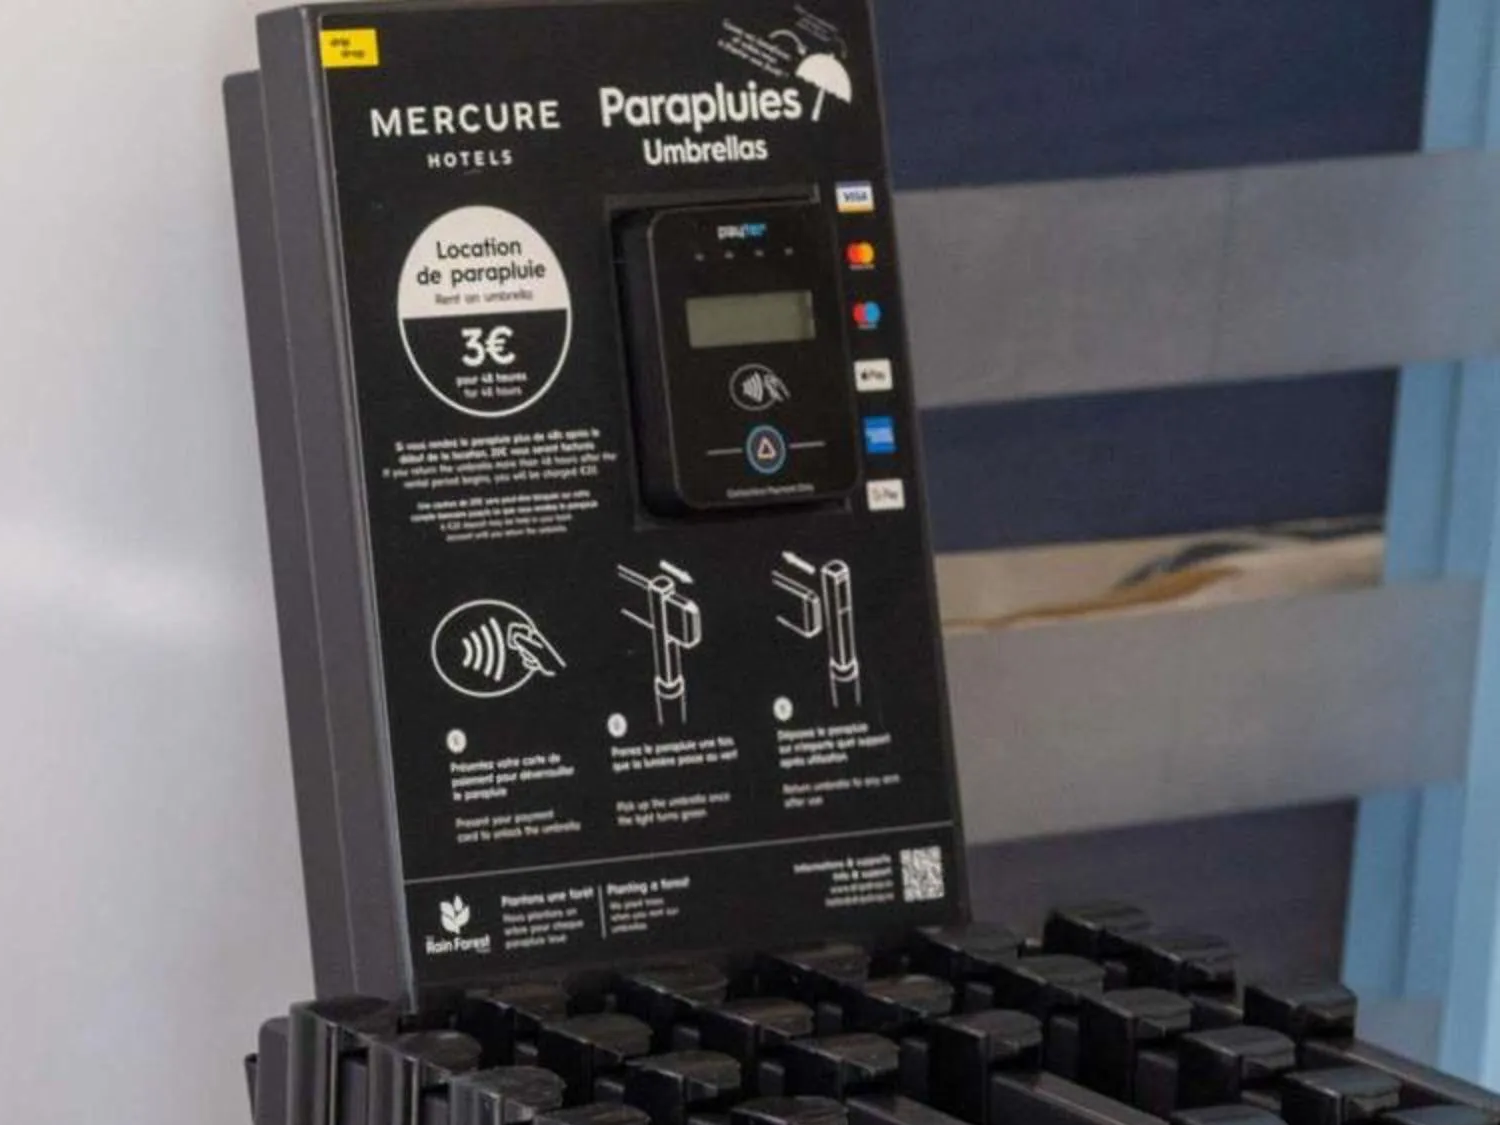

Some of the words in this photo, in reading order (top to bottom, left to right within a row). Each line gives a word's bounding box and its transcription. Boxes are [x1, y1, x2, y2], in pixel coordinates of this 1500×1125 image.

[371, 100, 559, 137] MERCURE
[600, 80, 801, 133] Parapluies
[428, 149, 512, 168] HOTELS
[643, 134, 767, 164] Umbrellas
[436, 237, 521, 260] Location
[417, 266, 441, 285] de
[451, 259, 546, 287] parapluie
[462, 325, 514, 367] 3€
[426, 938, 452, 954] Rain
[454, 934, 491, 951] Forest
